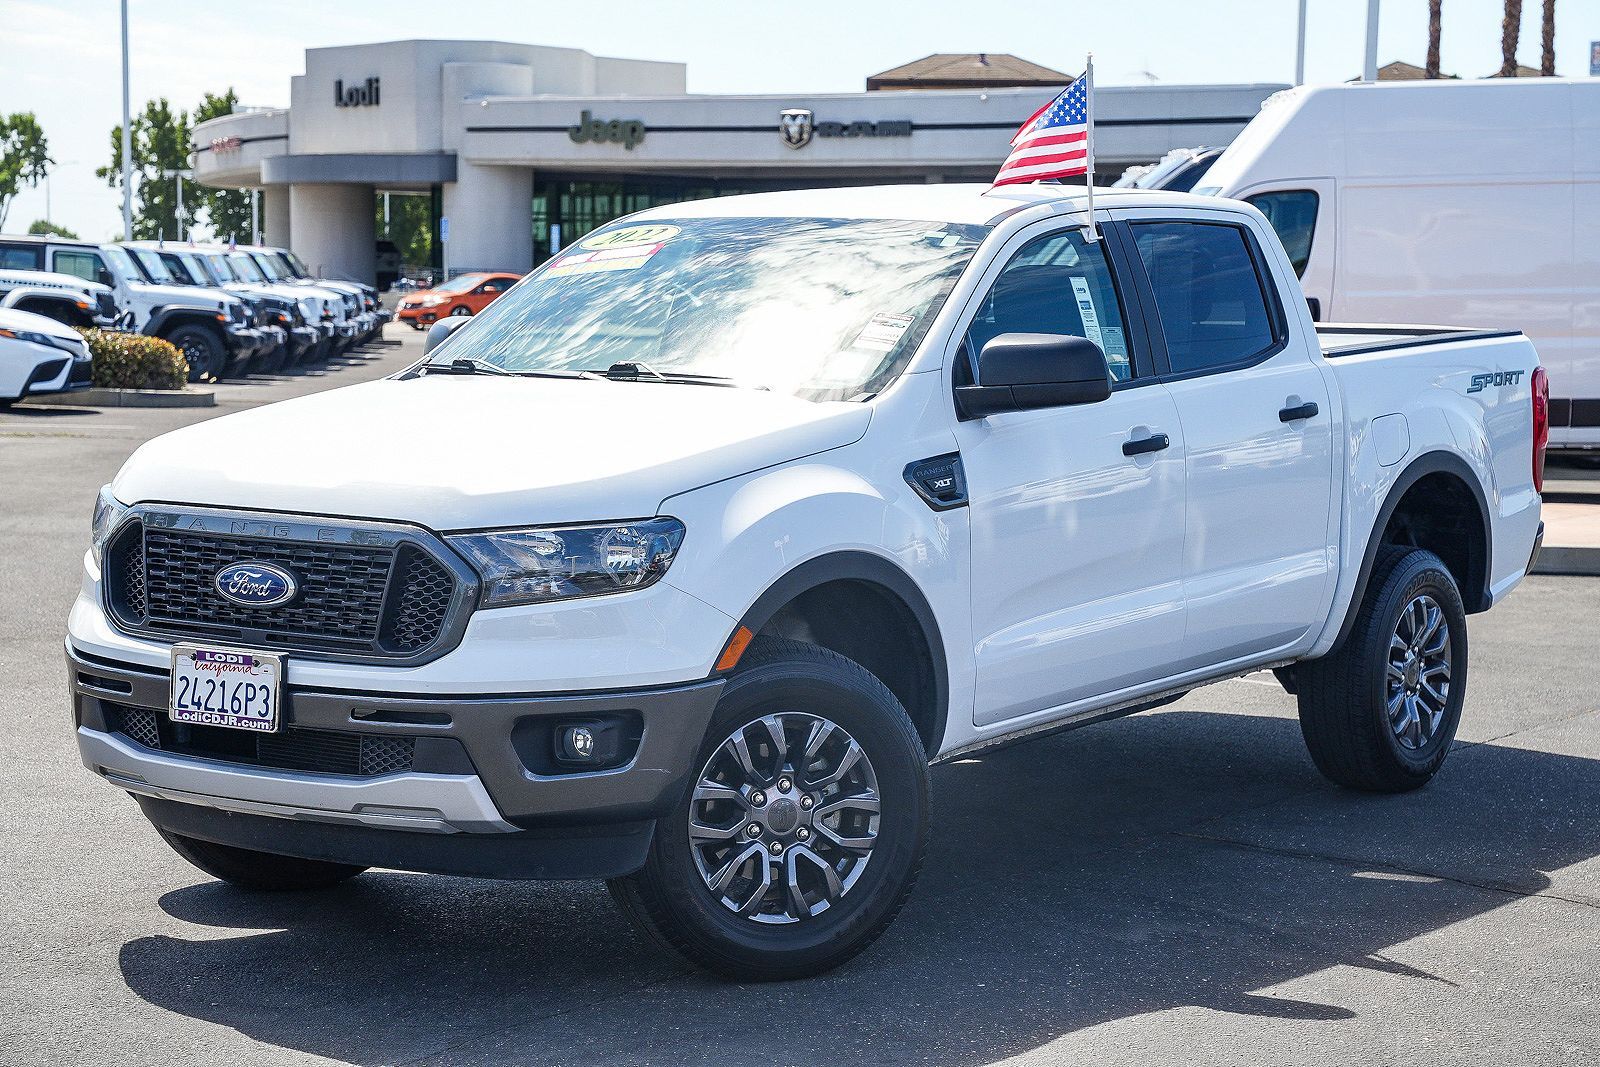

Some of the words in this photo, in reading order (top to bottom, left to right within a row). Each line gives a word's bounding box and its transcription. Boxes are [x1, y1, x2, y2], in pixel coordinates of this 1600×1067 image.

[333, 76, 381, 107] Lodi
[568, 109, 646, 151] Jeep
[816, 120, 914, 138] RAM
[1466, 369, 1525, 394] SPORT
[916, 464, 953, 478] RANGER
[934, 477, 953, 489] XLT
[154, 514, 384, 546] RANGER
[229, 570, 273, 597] Ford
[194, 660, 260, 678] California
[205, 652, 244, 664] LODI
[177, 675, 271, 718] 24216P3
[174, 709, 271, 731] LodiCDJR.com
